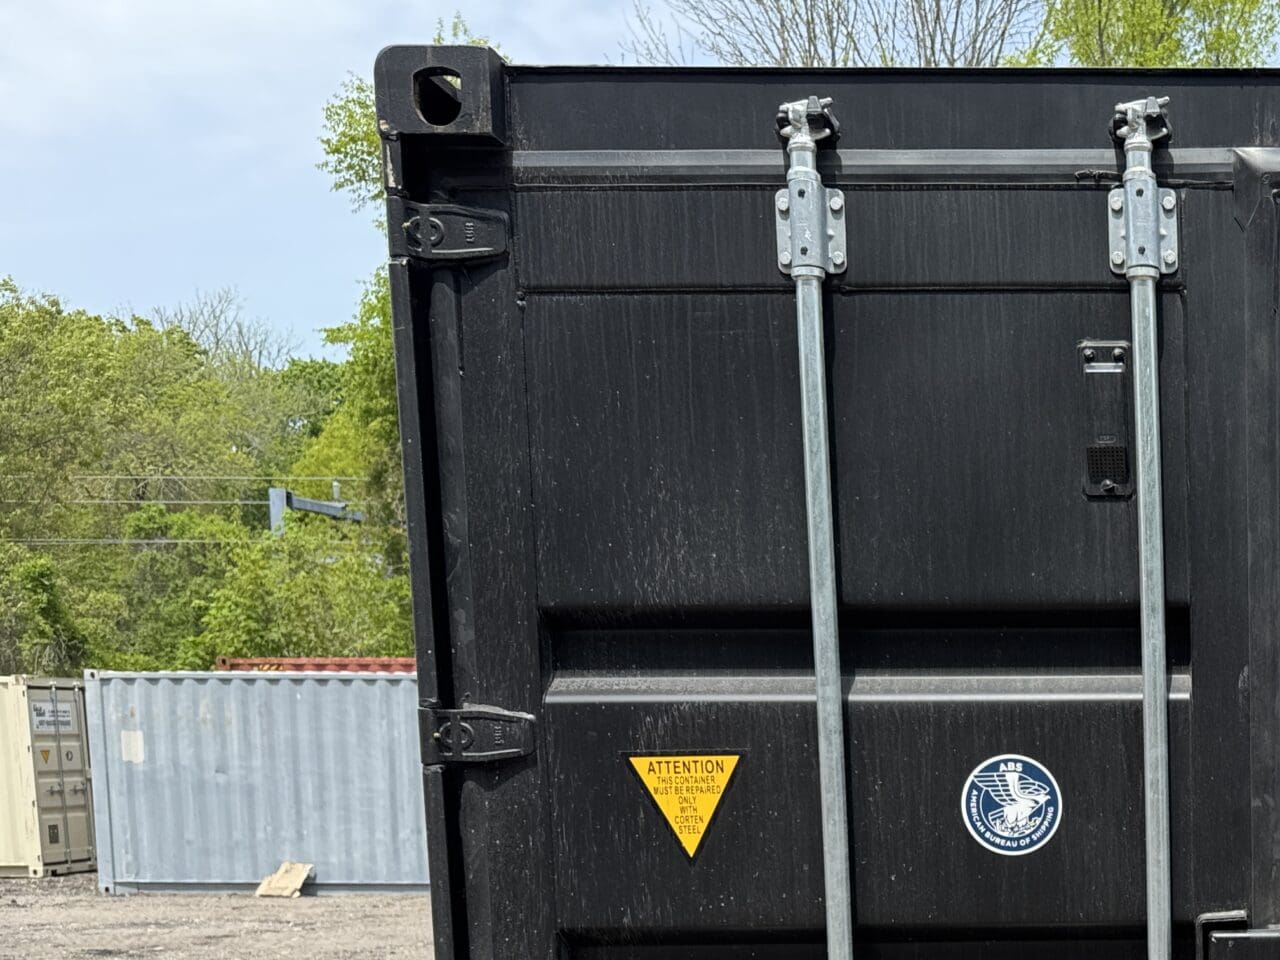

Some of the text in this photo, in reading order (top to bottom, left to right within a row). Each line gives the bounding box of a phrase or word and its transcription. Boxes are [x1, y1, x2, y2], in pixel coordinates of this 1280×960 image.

[647, 760, 725, 775] ATTENTION
[999, 762, 1023, 772] ABS
[657, 775, 716, 785] THIS CONTAINER
[653, 785, 721, 795] MUST BE REPAIRED
[678, 796, 697, 805] ONLY
[680, 806, 697, 815] WITH
[674, 815, 704, 825] CORTEN
[970, 789, 1054, 848] AMERICAN BUREAU OF SHIPPING
[678, 825, 701, 834] STEEL
